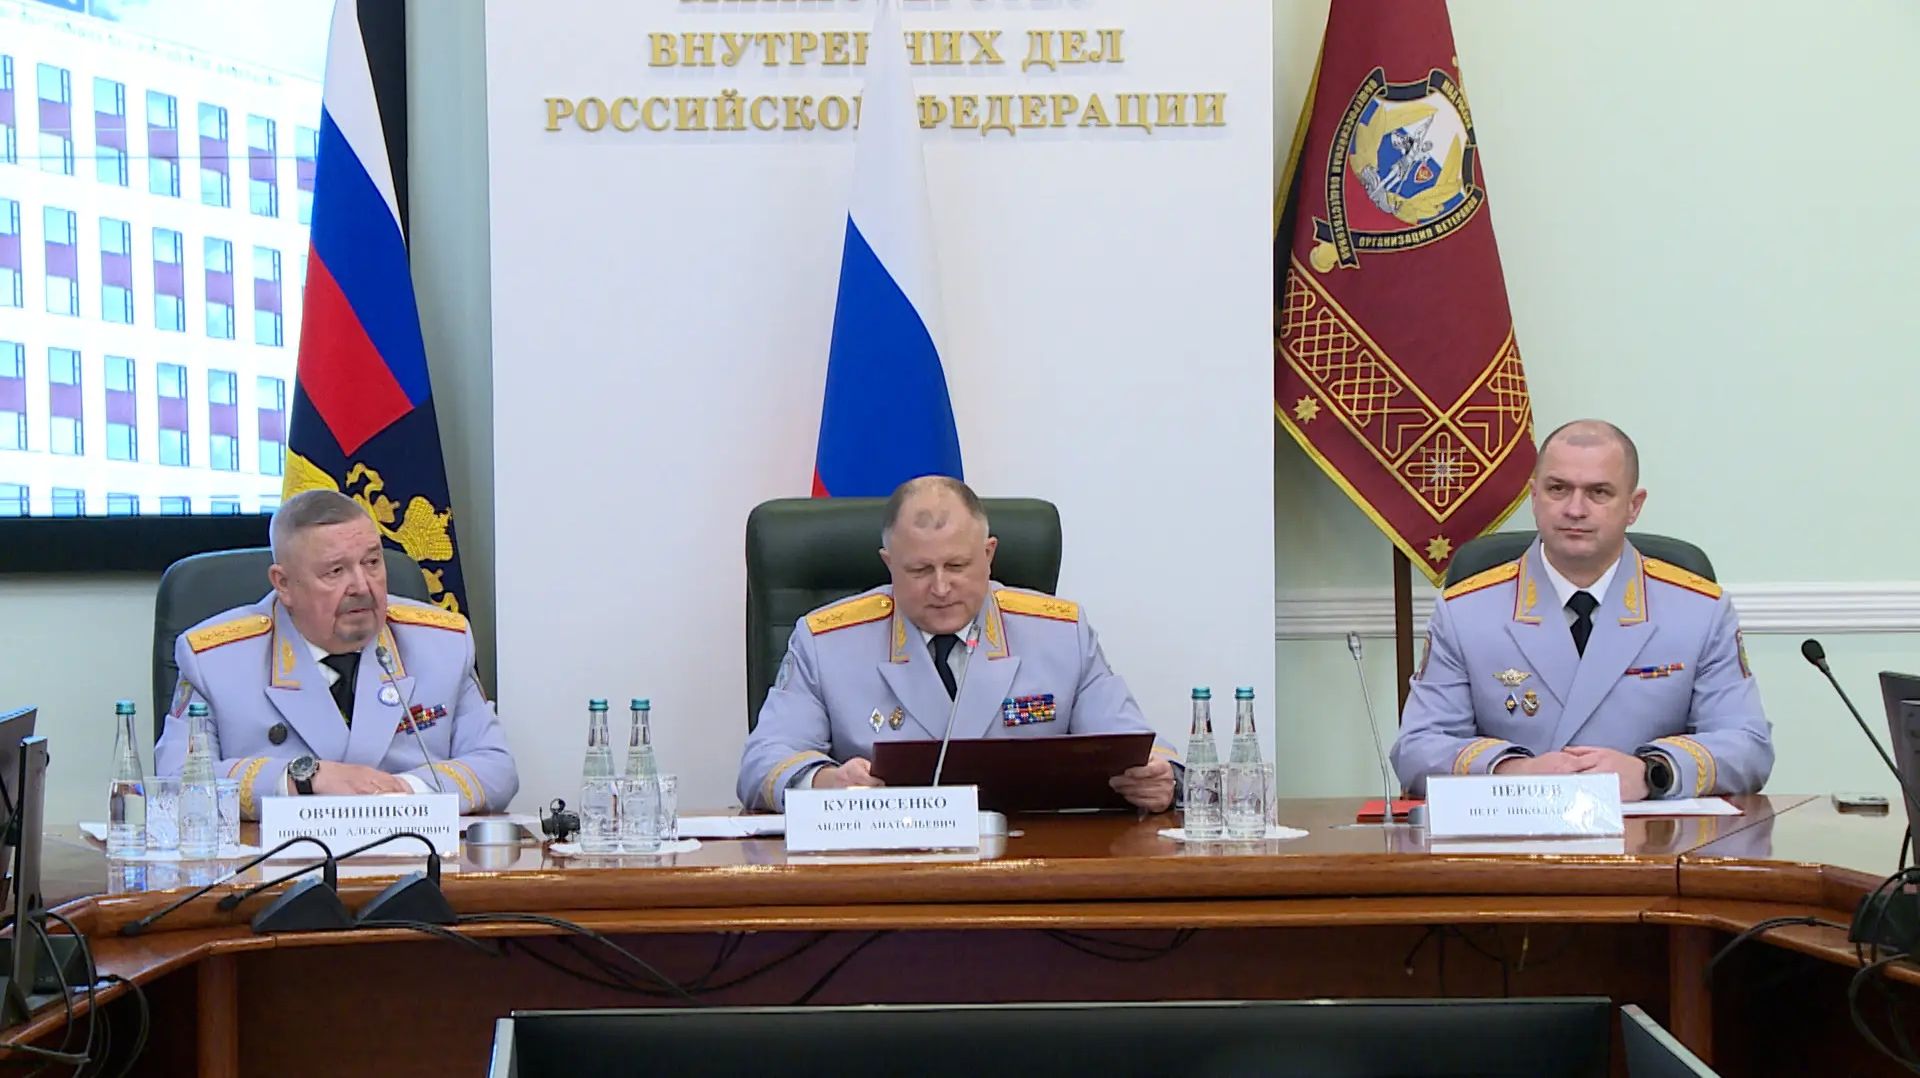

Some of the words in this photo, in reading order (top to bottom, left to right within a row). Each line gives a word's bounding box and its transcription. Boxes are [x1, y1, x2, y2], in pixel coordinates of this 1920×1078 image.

[1021, 29, 1124, 71] ДЕЛ
[545, 89, 863, 132] РОССИЙСКО
[917, 92, 1227, 134] ФЕДЕРАЦИИ
[1358, 227, 1433, 248] ОРГАНИЗАЦИЯ
[1491, 783, 1562, 798] ПЕРЦЕВ
[823, 796, 948, 812] КУРНОСЕНКО
[1469, 807, 1499, 817] ПЕТР
[1507, 805, 1586, 817] НИКОЛАЕ
[299, 804, 429, 821] ОВЧИННИКОВ
[278, 826, 337, 839] НИКОЛАЙ
[346, 825, 451, 837] АЛЕКСАНДРОВИЧ
[816, 820, 862, 833] АНДРЕЙ
